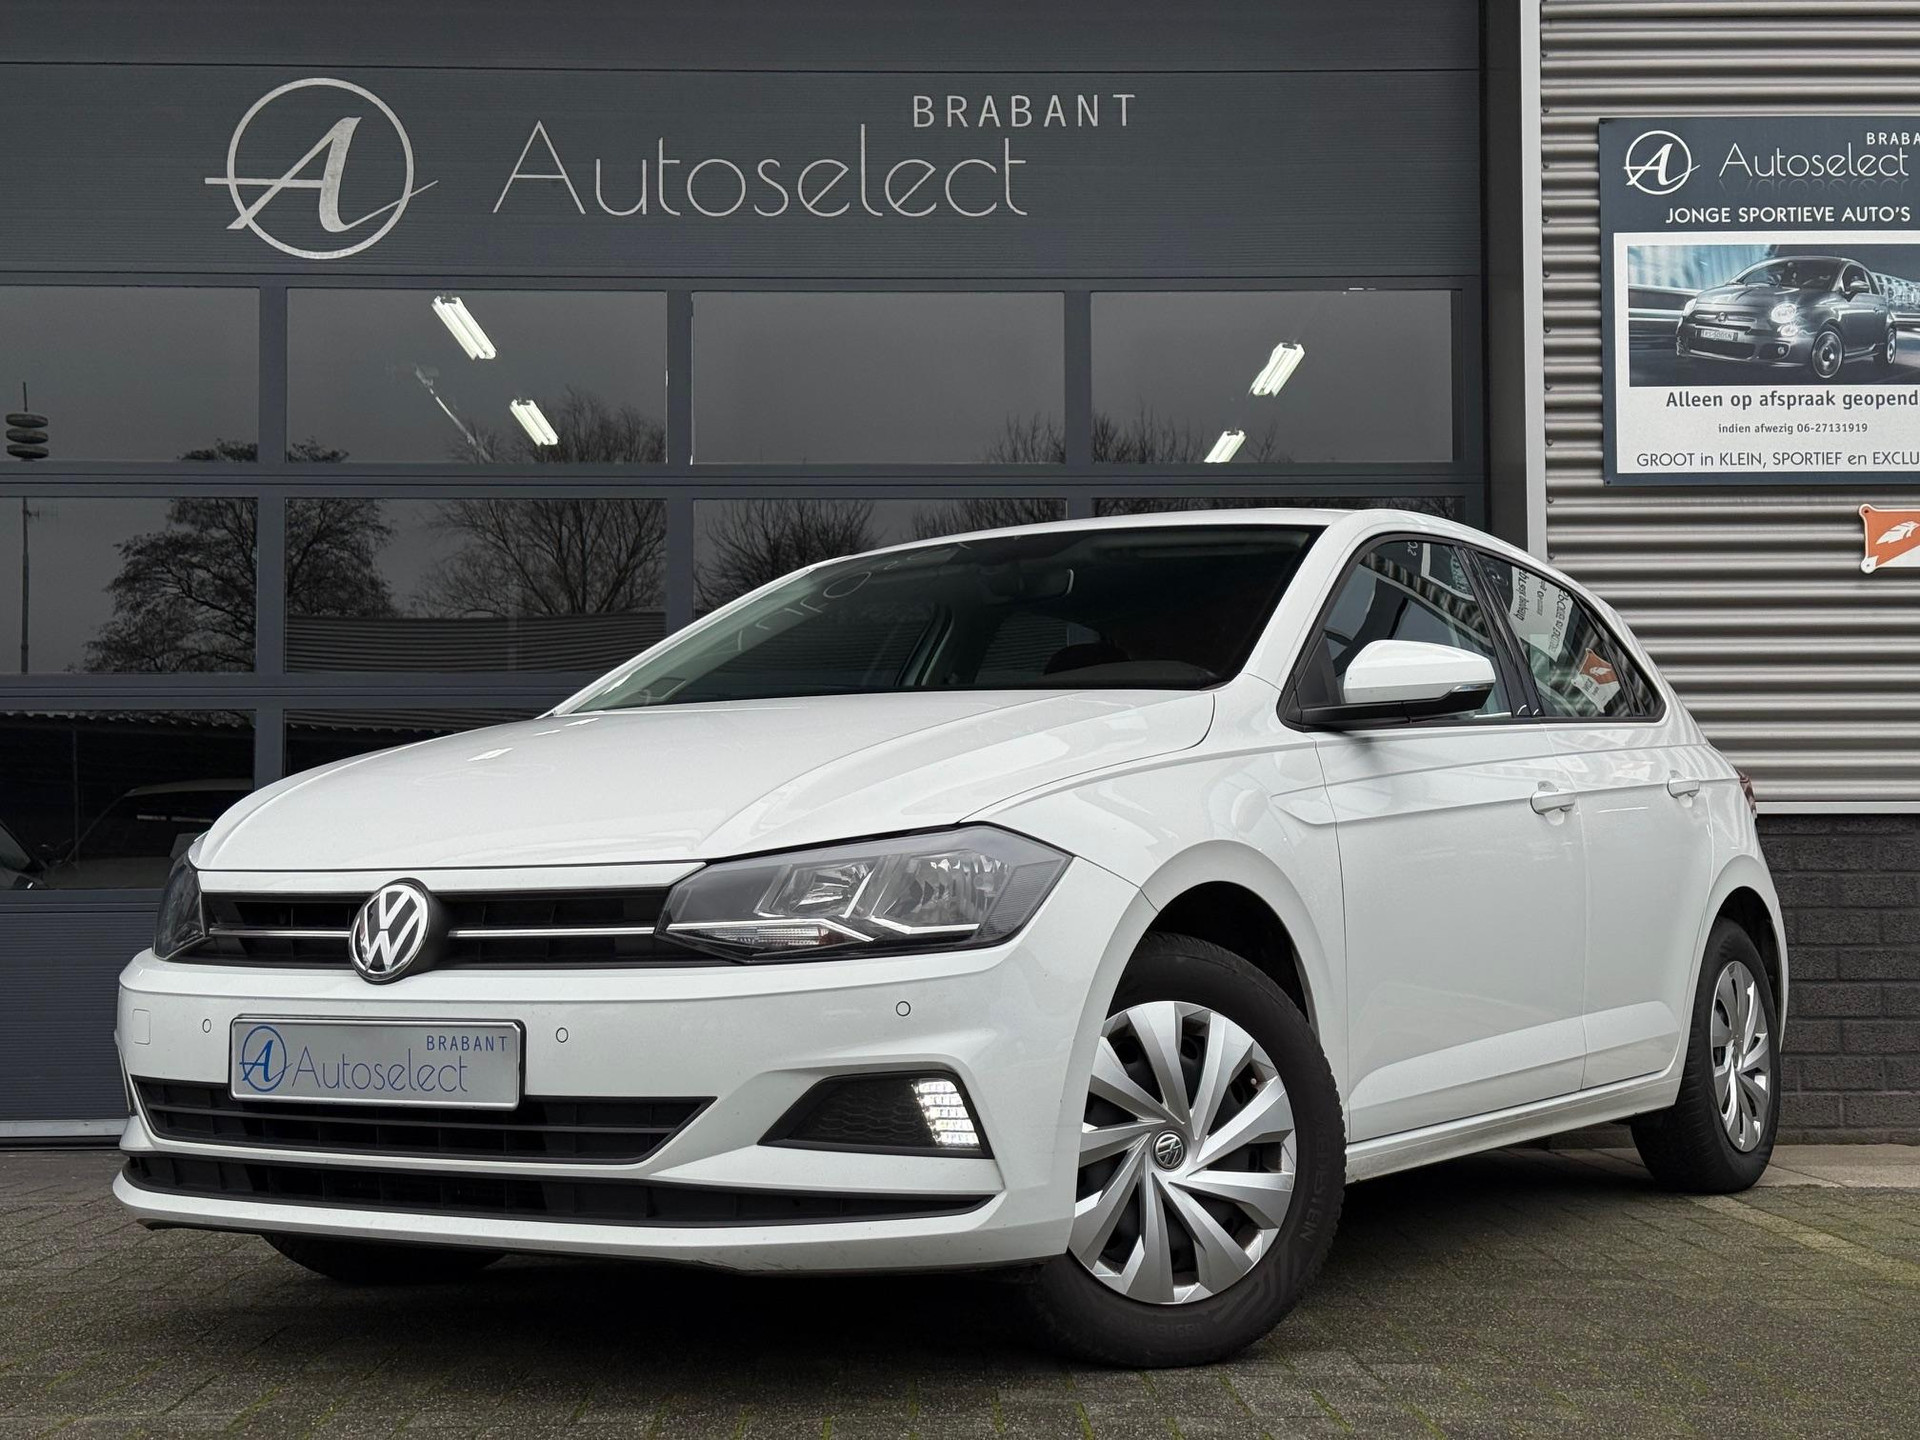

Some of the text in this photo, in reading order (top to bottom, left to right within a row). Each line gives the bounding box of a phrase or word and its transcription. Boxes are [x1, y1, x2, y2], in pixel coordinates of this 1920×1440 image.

[913, 94, 1136, 128] BRABANT
[492, 120, 1028, 218] Autoselect
[1719, 141, 1910, 178] Autoselect
[1665, 206, 1911, 224] JONGE SPORTIEVE AUTO'S
[1665, 389, 1919, 411] Alleen op afspraak geopend
[1718, 422, 1868, 435] indien afwezig 06-27131919
[1636, 452, 1695, 467] GROOT
[1700, 452, 1714, 466] in
[1719, 452, 1767, 469] KLEIN,
[1772, 451, 1843, 466] SPORTIEF
[1847, 454, 1867, 466] en
[426, 1035, 509, 1052] BRABANT
[292, 1045, 469, 1093] Autoselect
